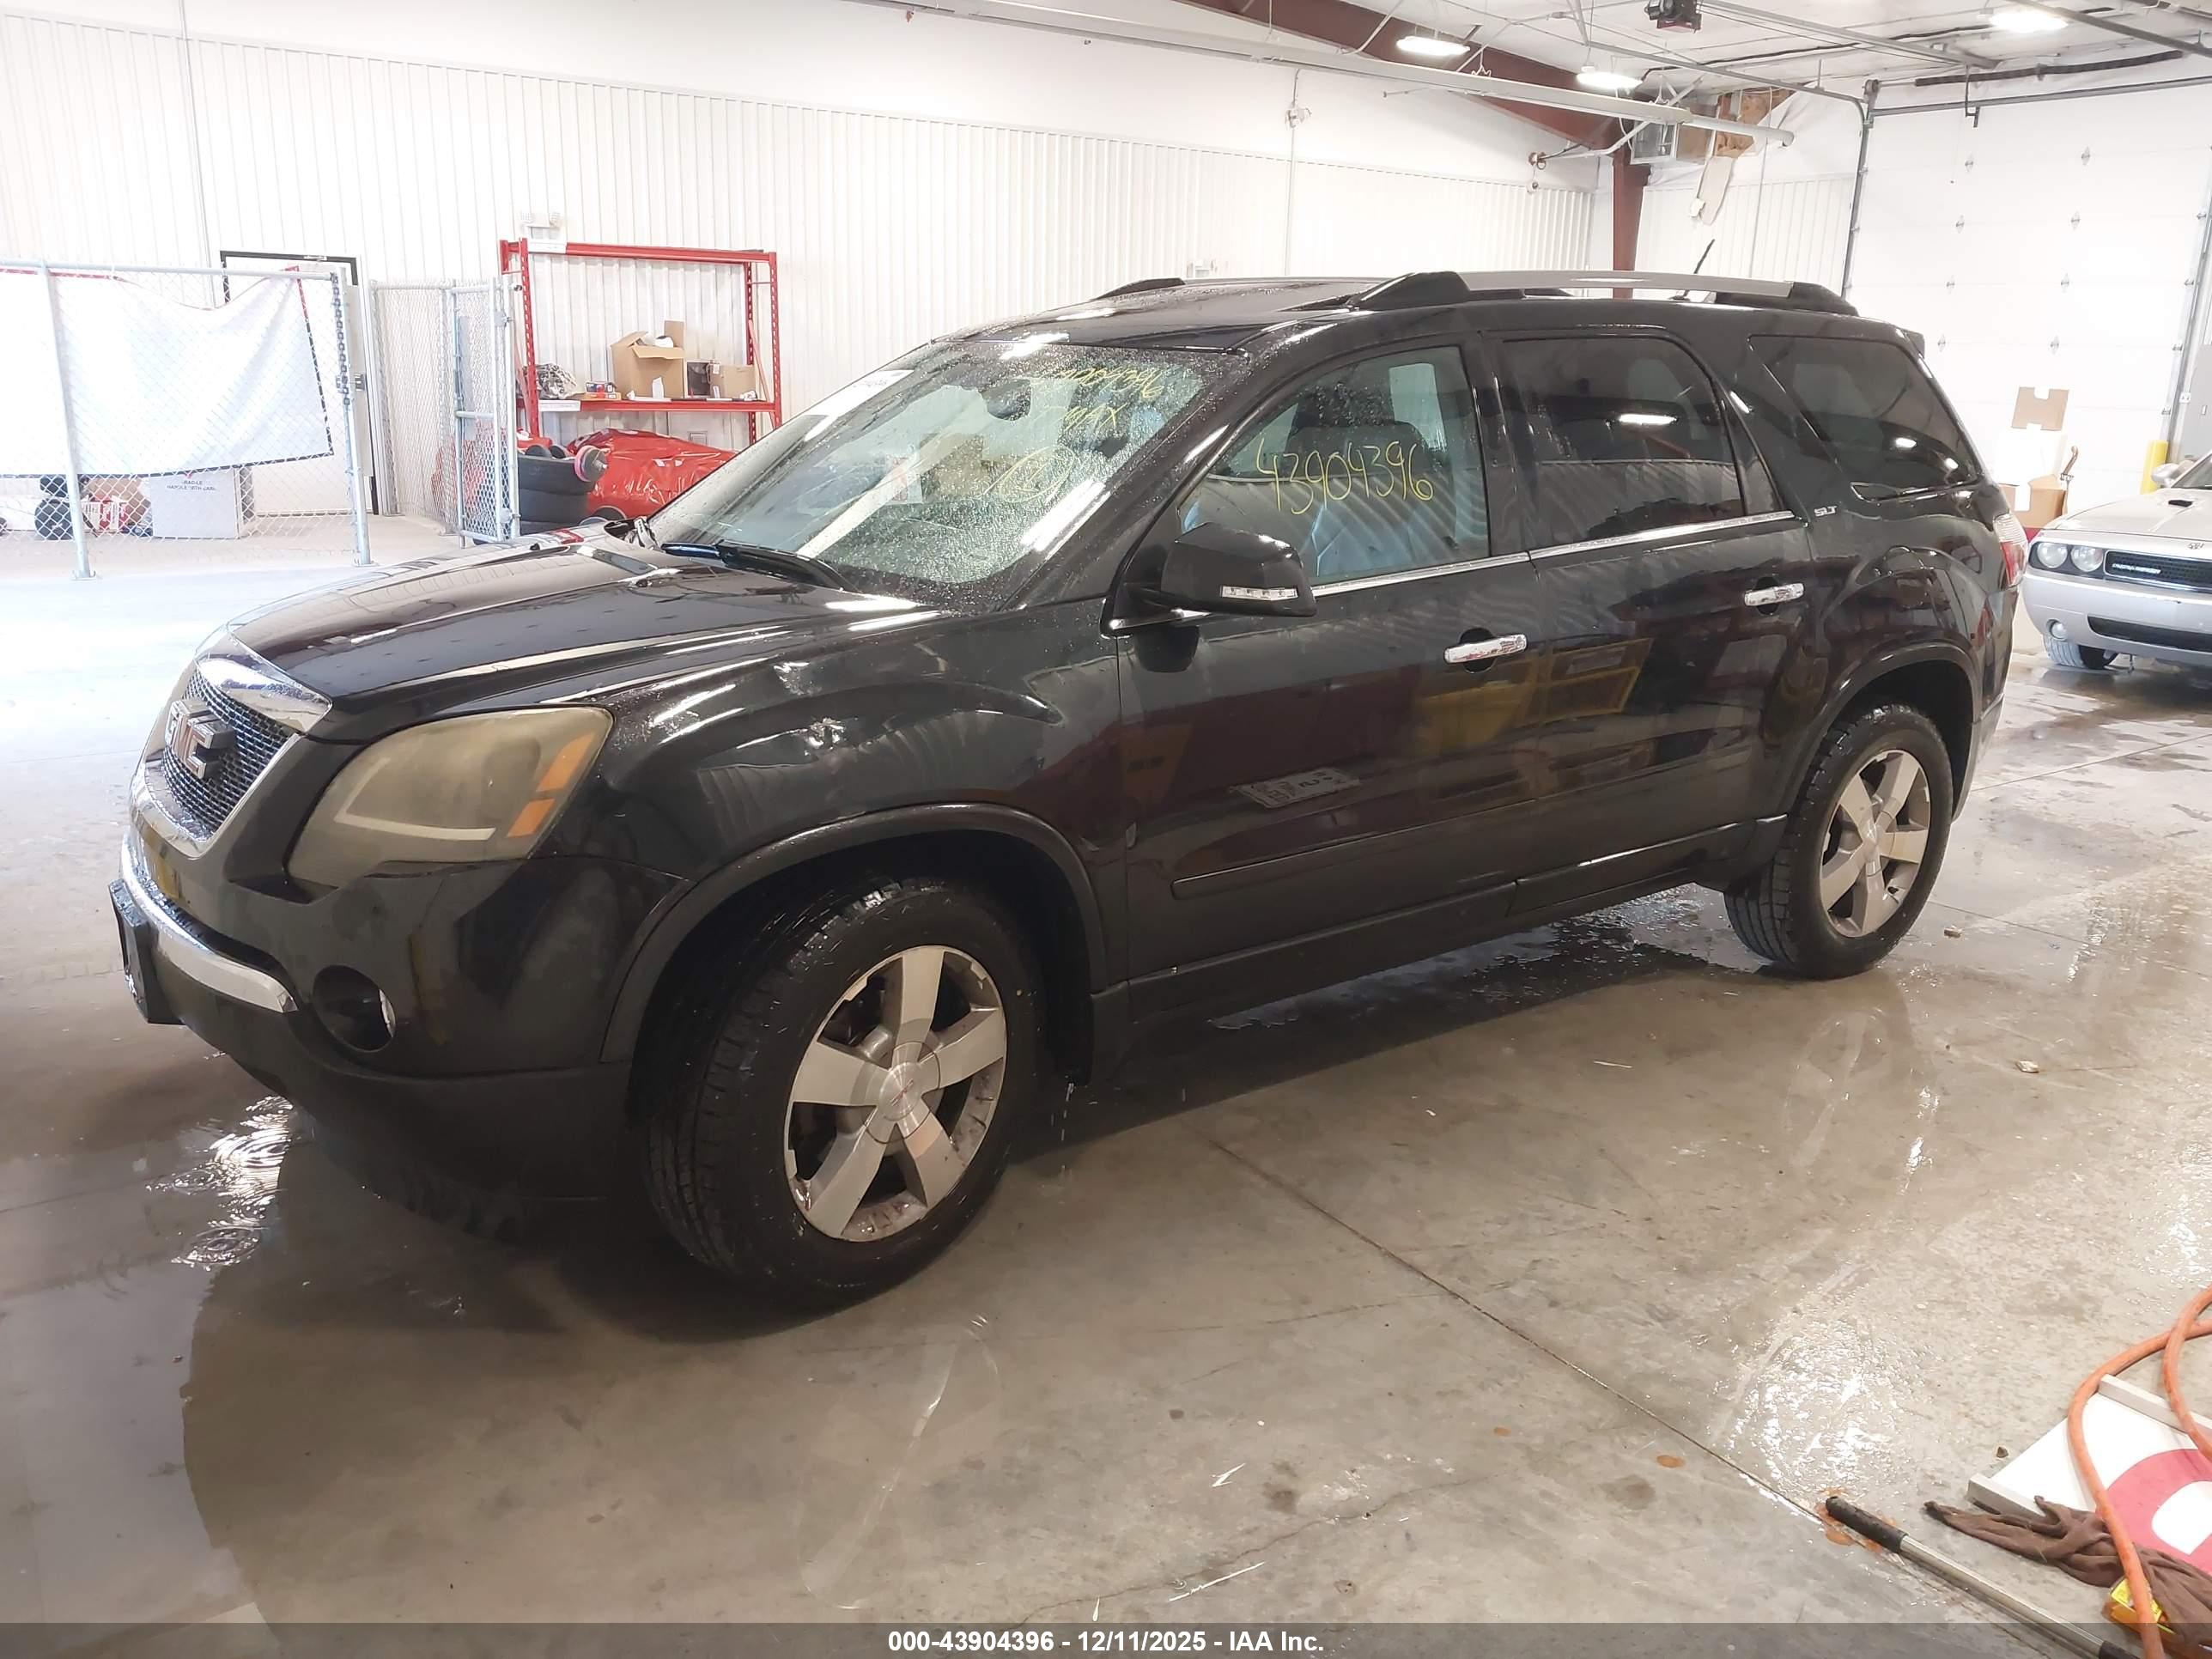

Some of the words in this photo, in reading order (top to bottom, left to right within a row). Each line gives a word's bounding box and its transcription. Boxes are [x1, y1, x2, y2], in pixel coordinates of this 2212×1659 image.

[1256, 438, 1434, 515] 43904396
[1814, 506, 1838, 517] SLT
[165, 699, 215, 780] GMC
